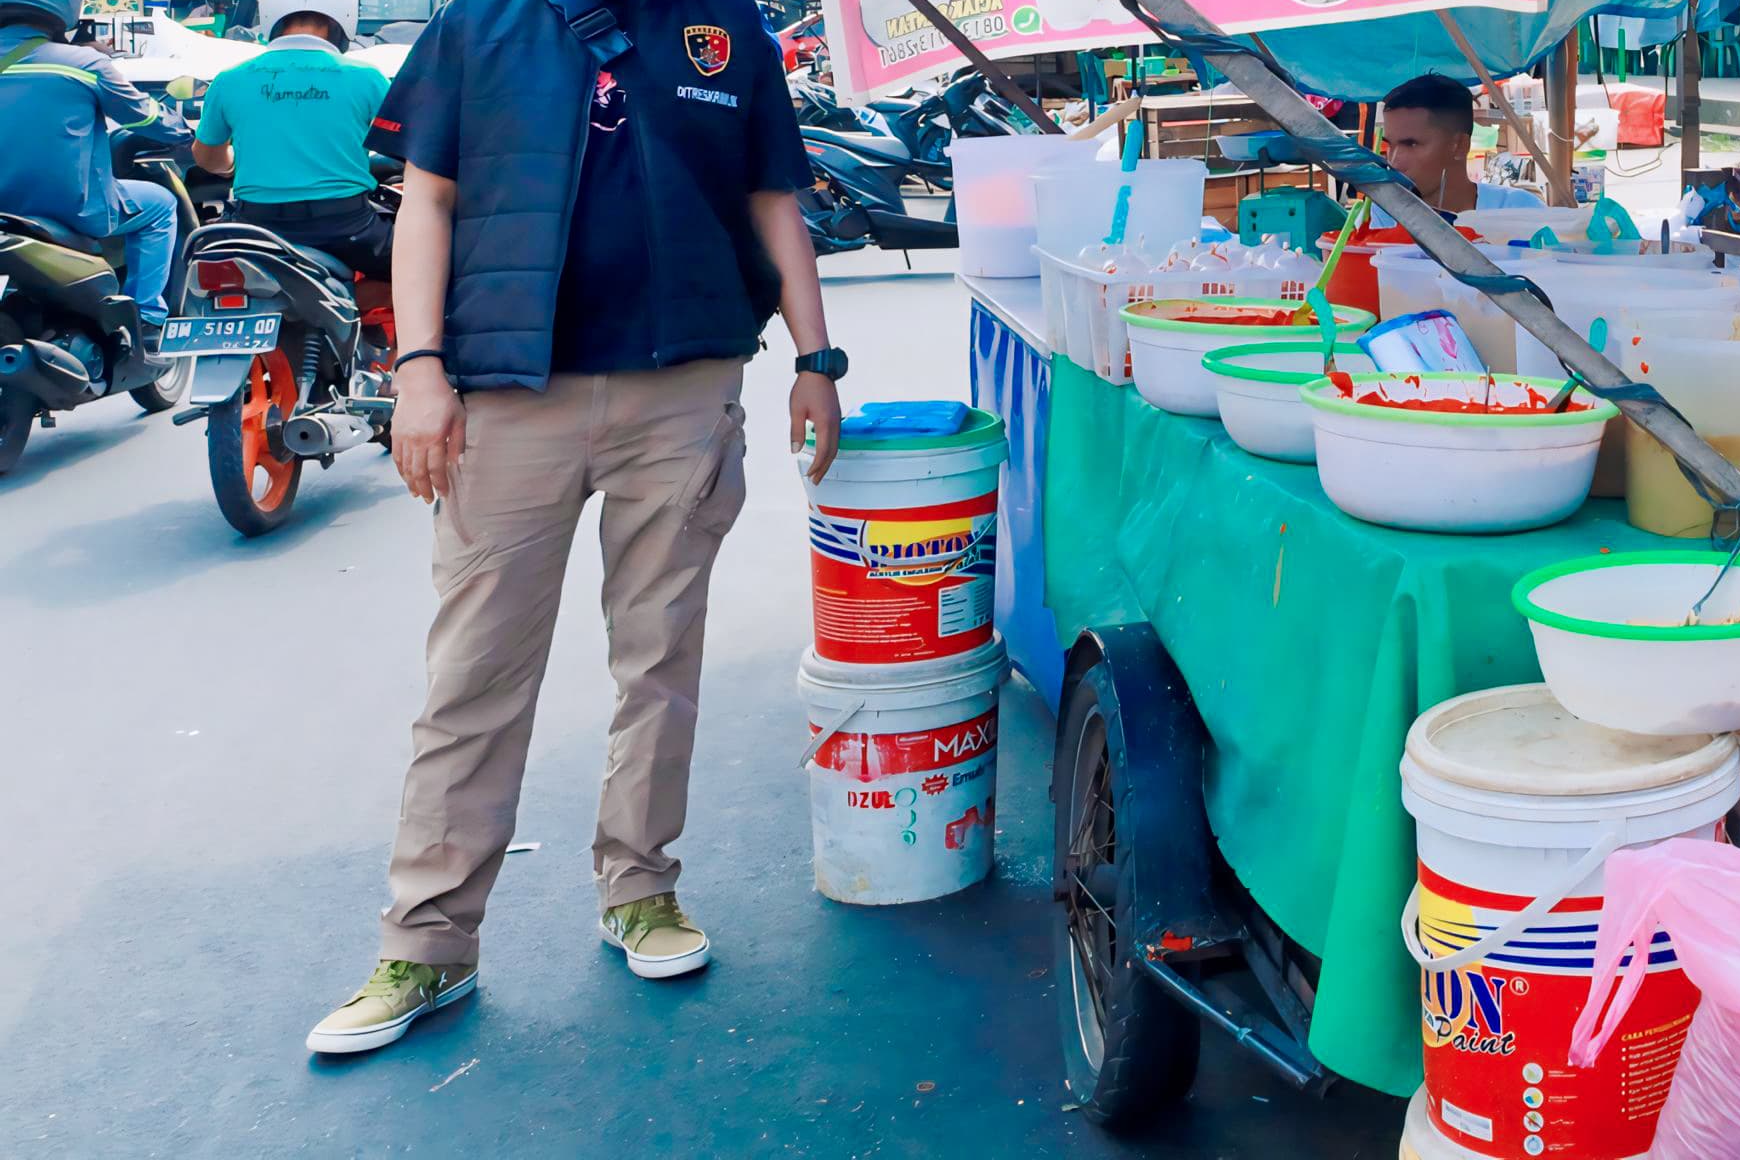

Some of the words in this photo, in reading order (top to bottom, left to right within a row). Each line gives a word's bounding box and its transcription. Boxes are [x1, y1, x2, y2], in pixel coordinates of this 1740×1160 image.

[204, 321, 244, 336] 5191
[848, 790, 896, 809] DZUL
[1434, 1015, 1516, 1055] Paint
